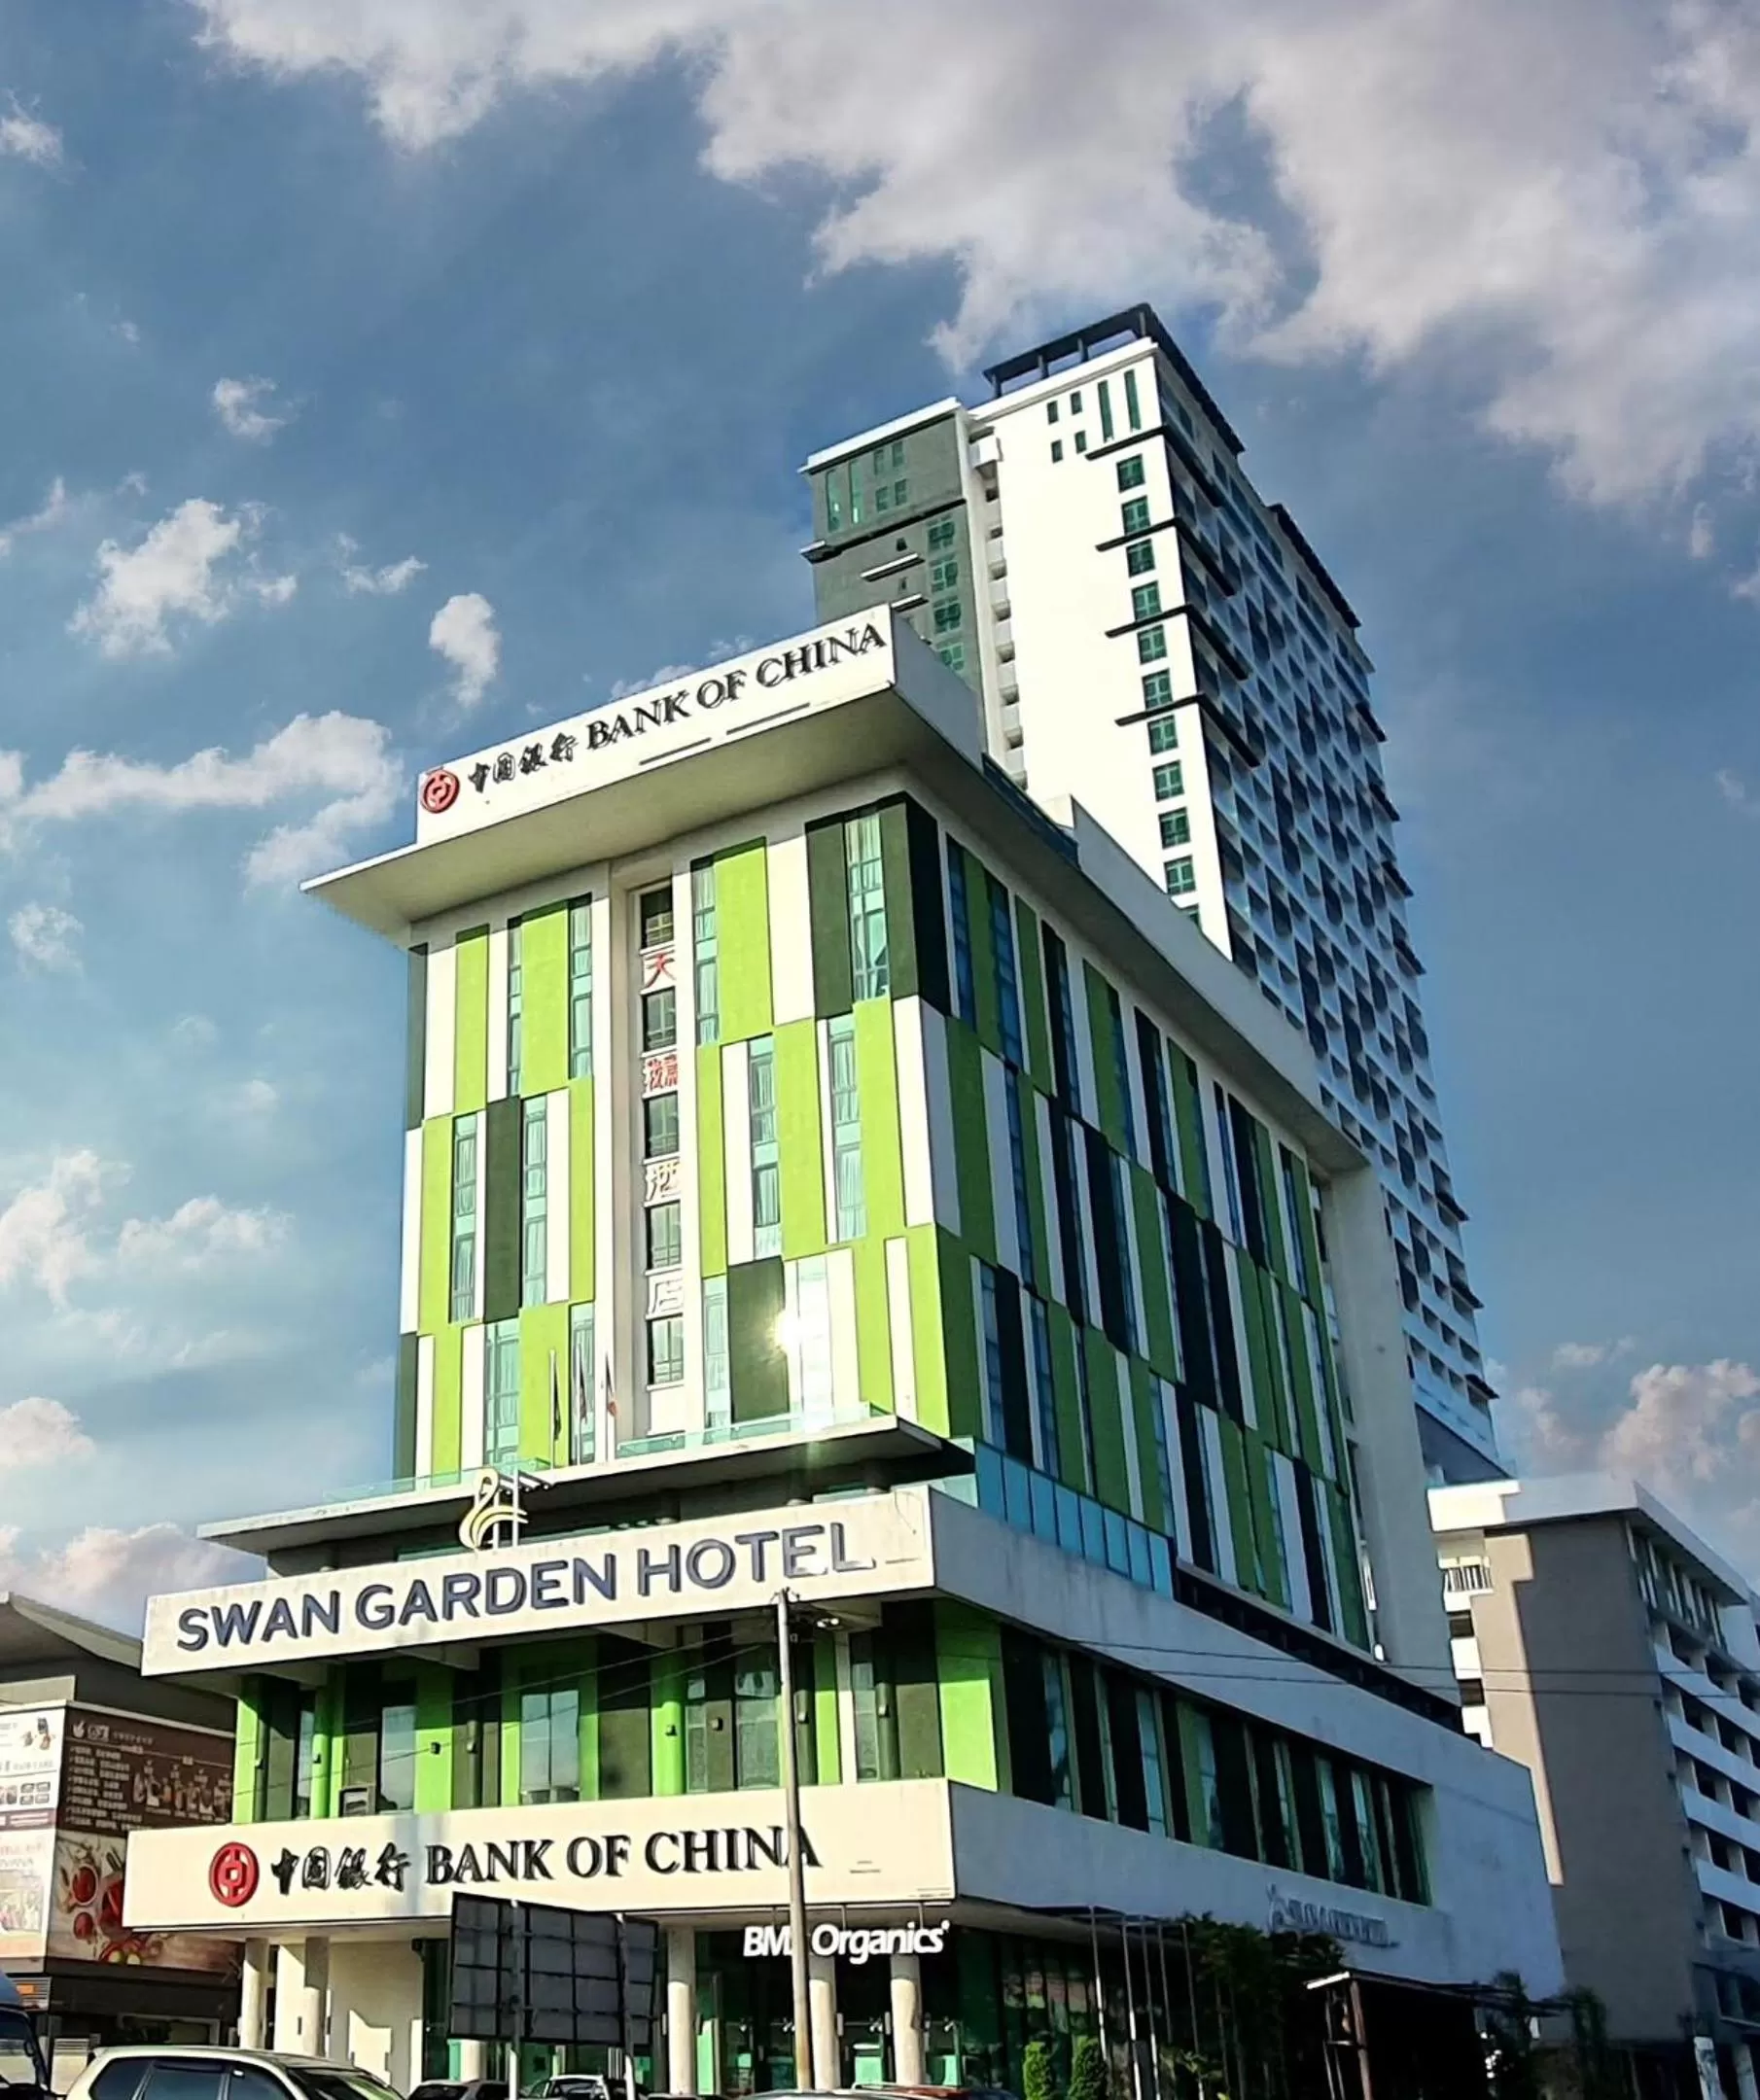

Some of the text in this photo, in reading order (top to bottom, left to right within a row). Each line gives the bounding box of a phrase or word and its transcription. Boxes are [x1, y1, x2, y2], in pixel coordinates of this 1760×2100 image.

[585, 623, 887, 751] BANK OF CHINA
[177, 1522, 876, 1652] SWAN GARDEN HOTEL
[425, 1825, 824, 1884] BANK OF CHINA
[743, 1921, 944, 1965] BM Organics
